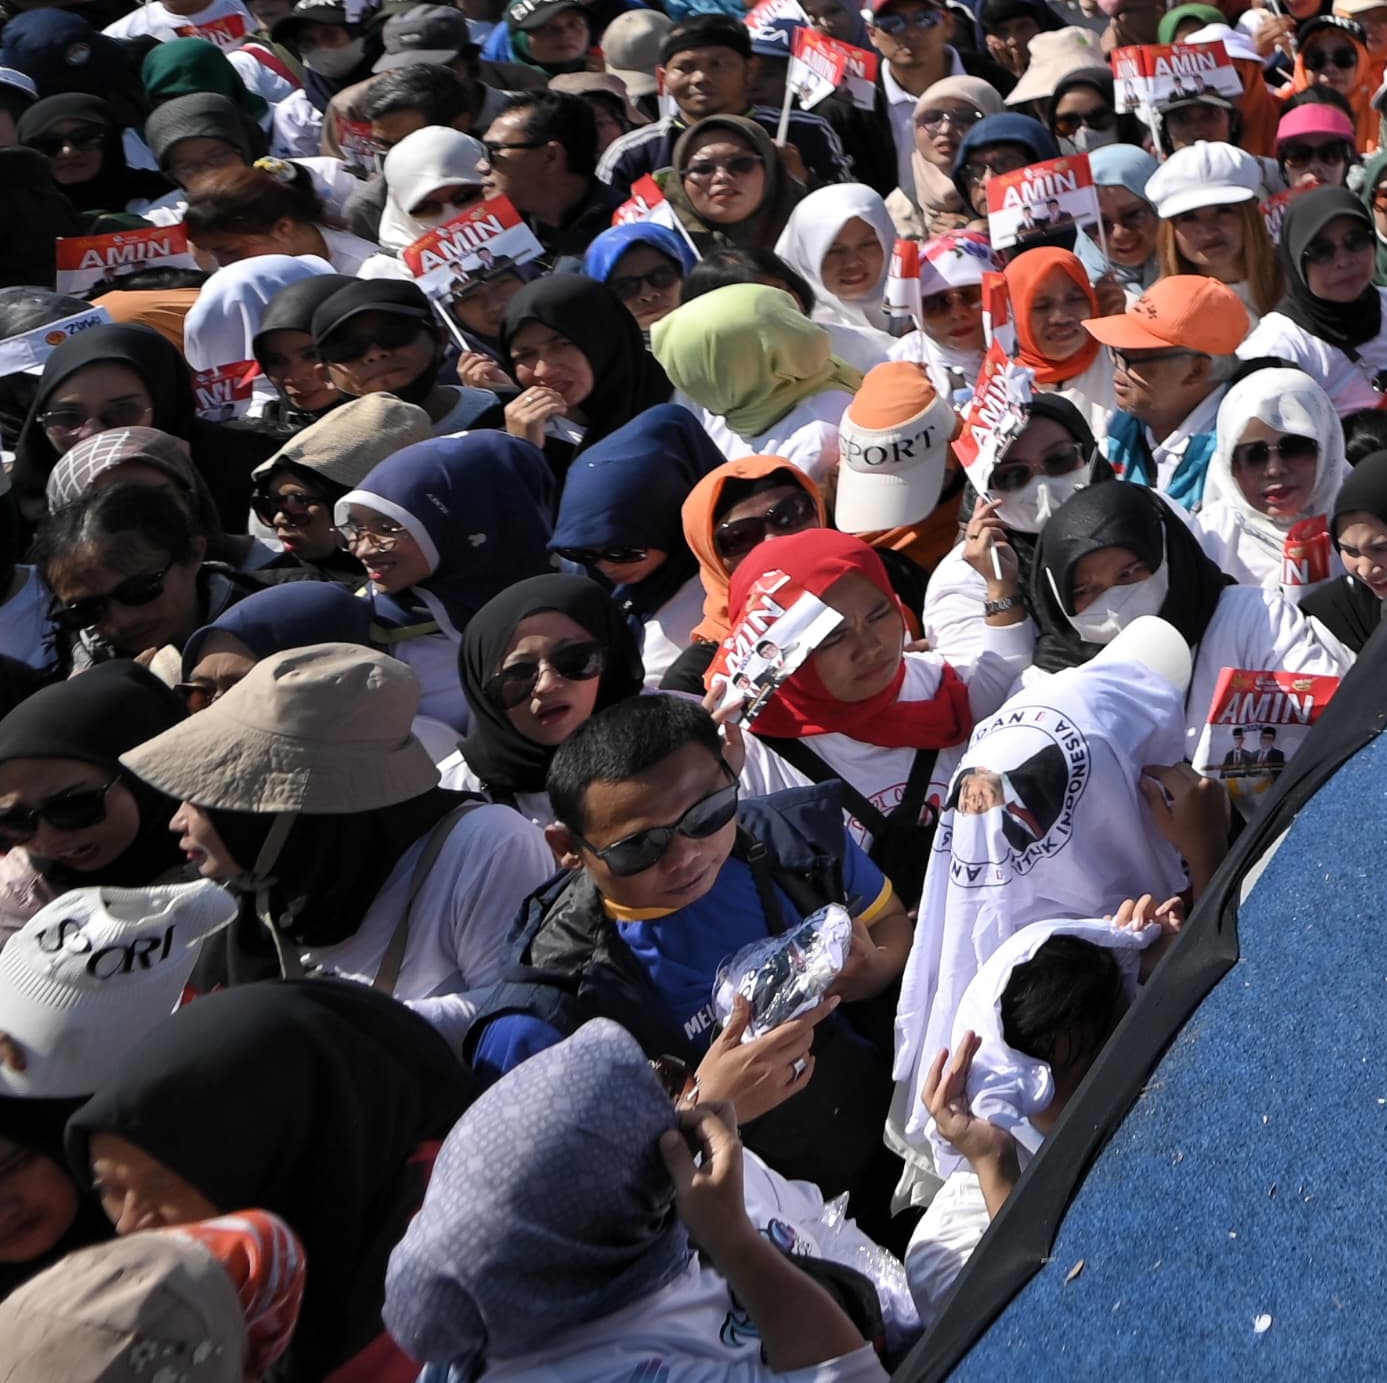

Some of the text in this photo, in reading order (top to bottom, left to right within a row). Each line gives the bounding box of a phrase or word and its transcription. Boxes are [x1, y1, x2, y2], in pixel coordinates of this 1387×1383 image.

[1154, 49, 1216, 79] AMIN
[1002, 168, 1077, 208] AMIN
[80, 237, 171, 270] AMIN
[418, 214, 504, 273] AMIN
[970, 360, 1011, 445] AMIN
[1219, 692, 1316, 725] AMIN
[1054, 719, 1086, 836] INDONESIA
